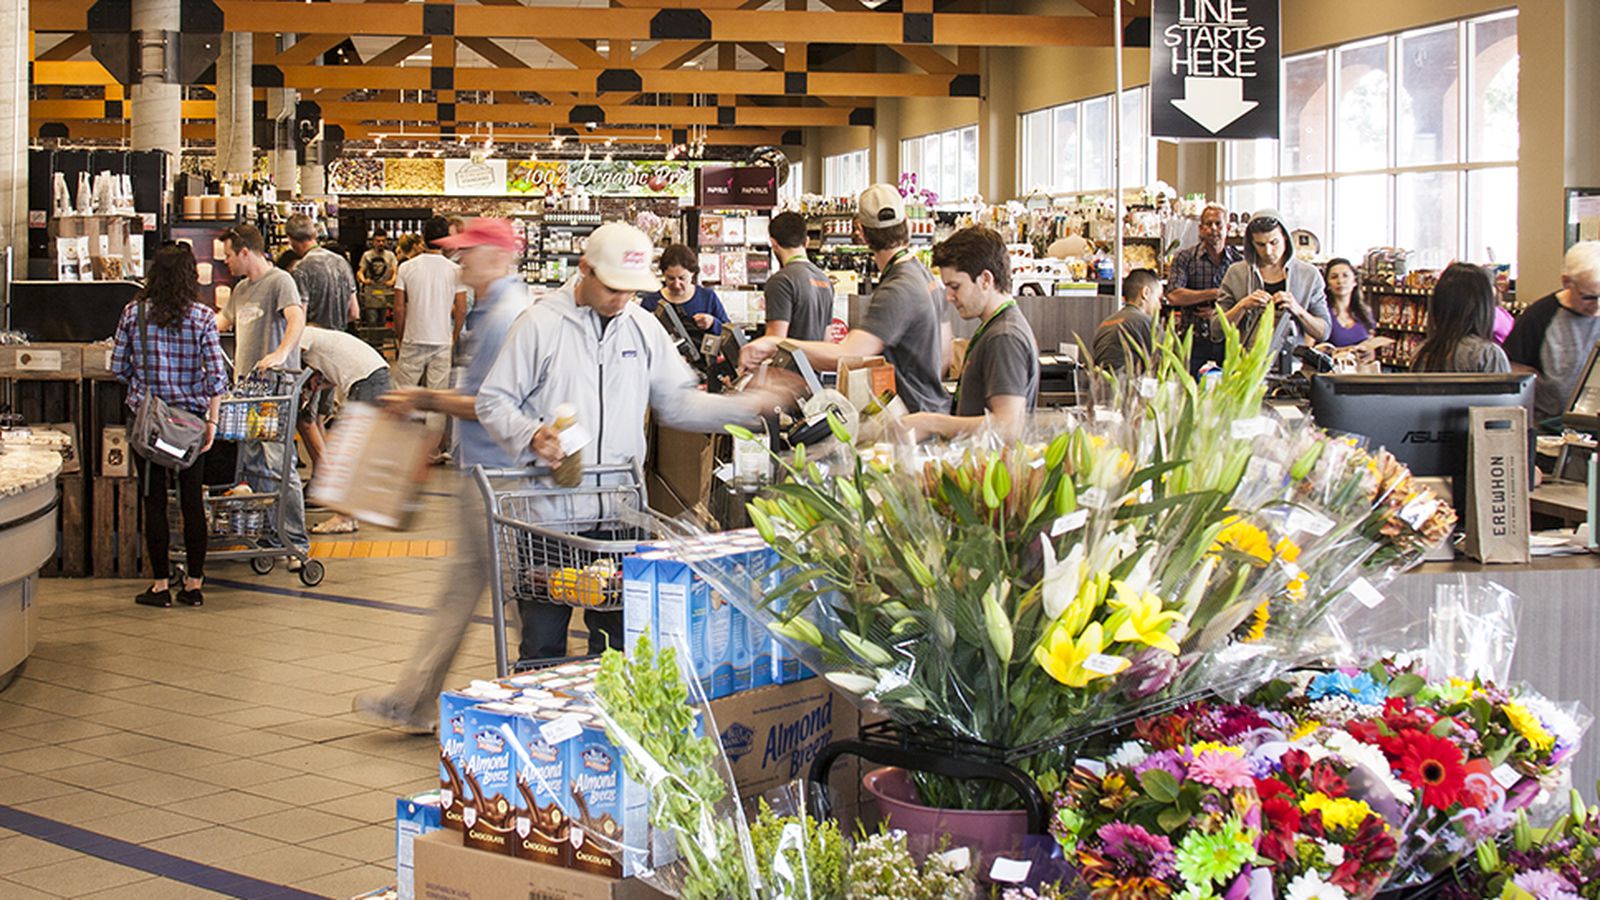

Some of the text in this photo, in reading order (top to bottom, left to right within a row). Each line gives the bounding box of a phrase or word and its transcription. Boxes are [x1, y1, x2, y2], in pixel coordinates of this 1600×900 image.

[1179, 0, 1248, 23] LINE
[1163, 24, 1266, 49] STARTS
[1171, 46, 1257, 77] HERE
[524, 164, 570, 185] 100%
[577, 163, 649, 193] Organic
[1401, 430, 1455, 443] ASUS
[1490, 456, 1506, 536] EREWHON
[762, 692, 833, 769] Almond
[466, 752, 509, 775] Almond
[574, 770, 616, 793] Almond
